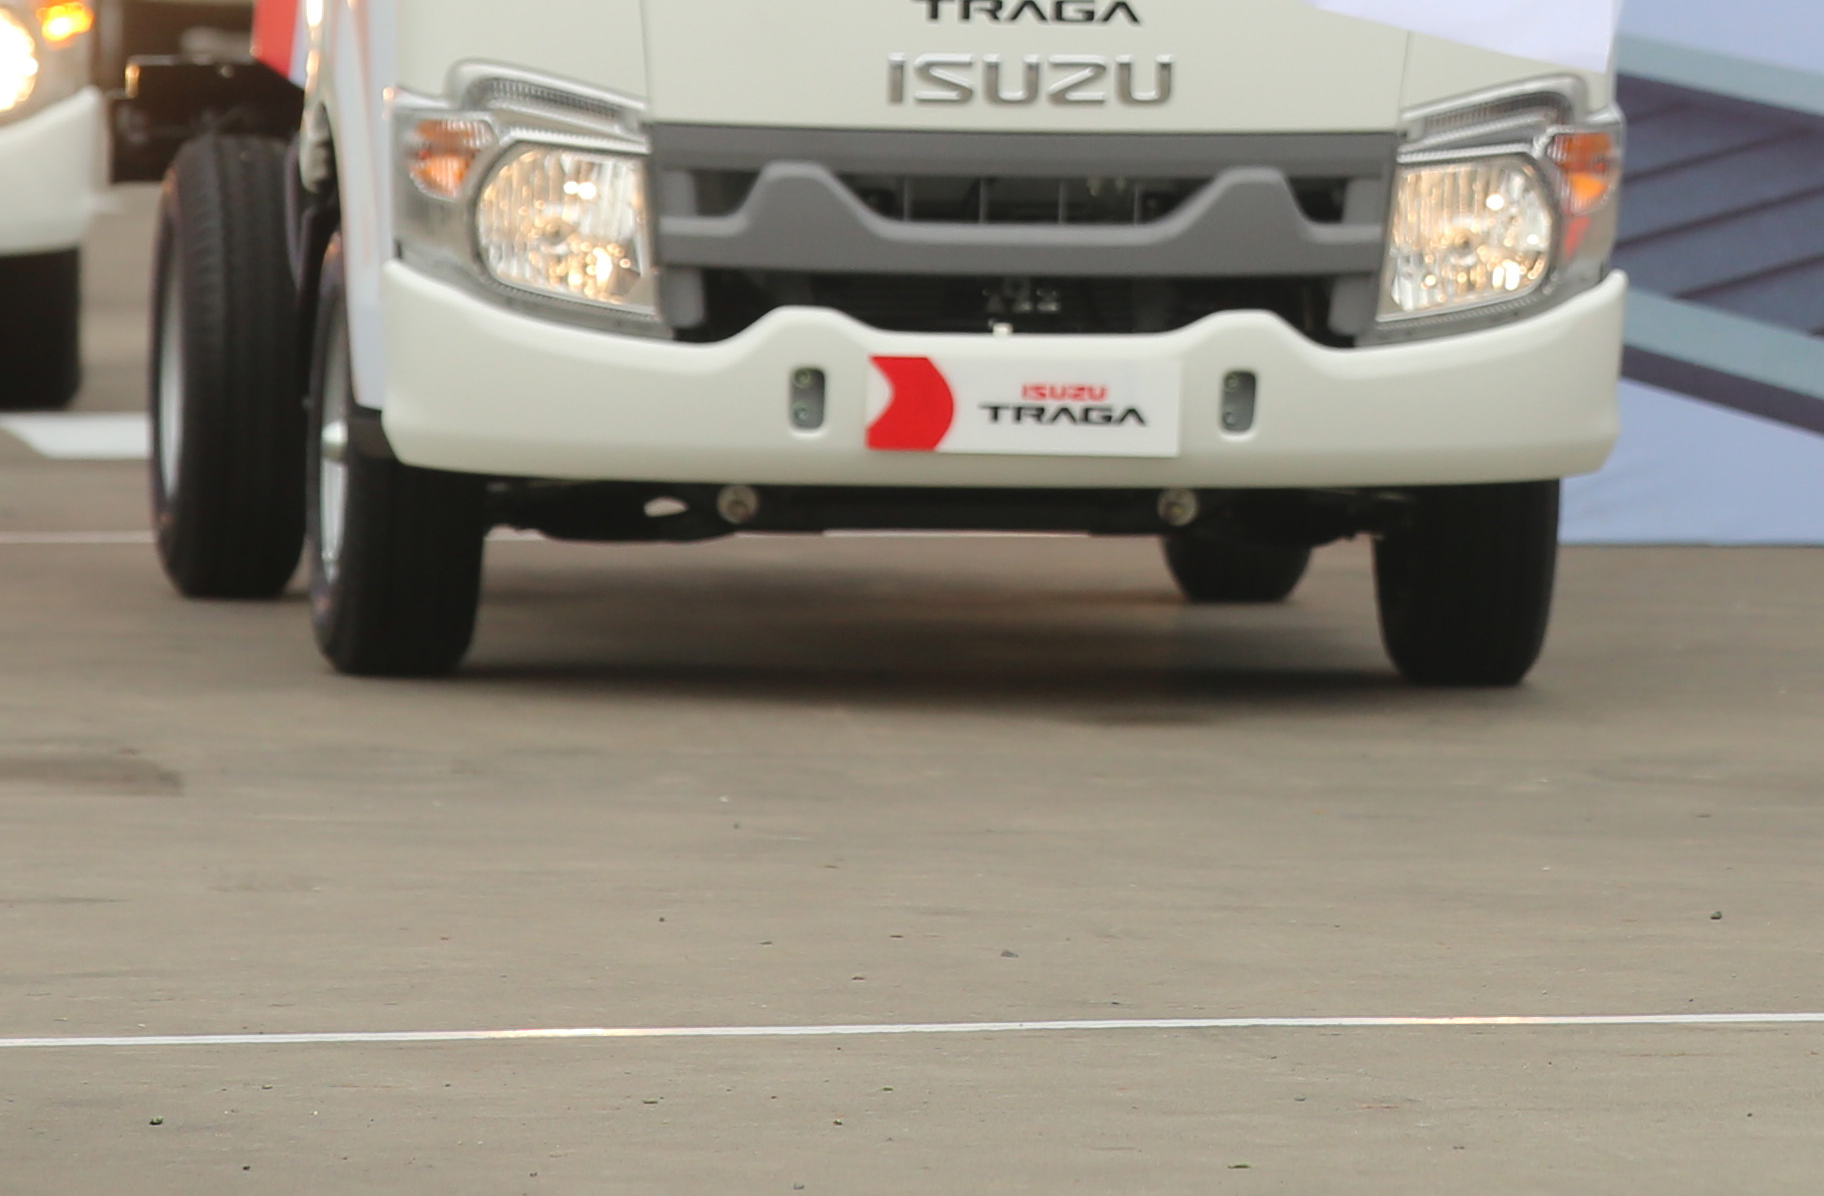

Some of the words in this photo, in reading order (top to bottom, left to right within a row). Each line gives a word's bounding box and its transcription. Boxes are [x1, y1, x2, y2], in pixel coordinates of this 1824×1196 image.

[887, 52, 1174, 105] ISUZU
[1022, 384, 1108, 401] ISUZU
[979, 405, 1147, 426] TRAGA
